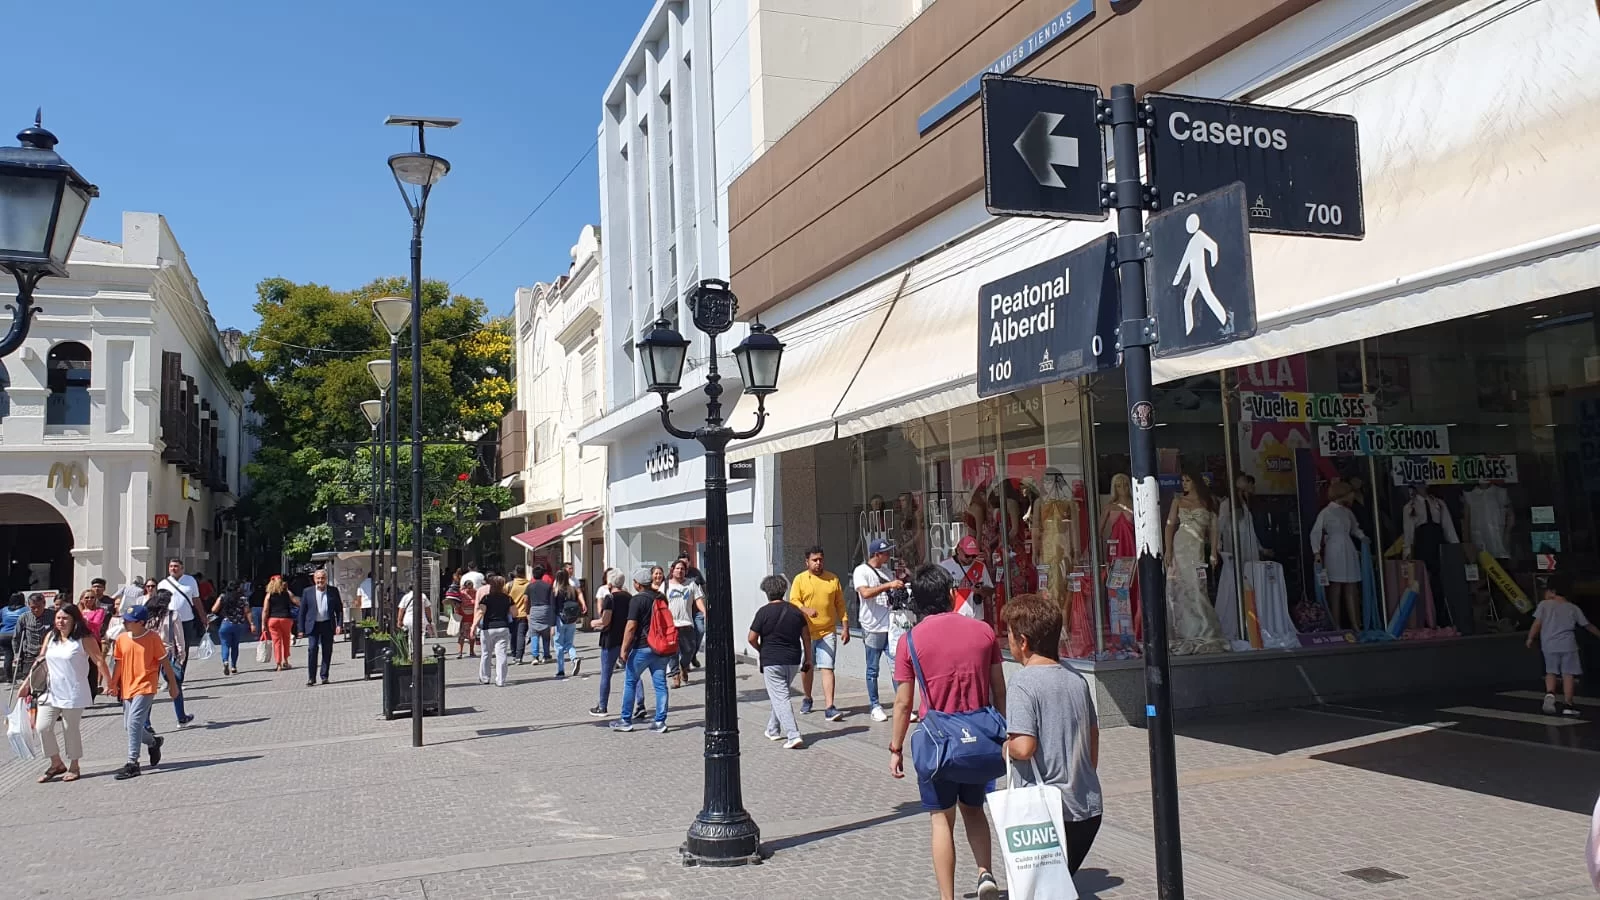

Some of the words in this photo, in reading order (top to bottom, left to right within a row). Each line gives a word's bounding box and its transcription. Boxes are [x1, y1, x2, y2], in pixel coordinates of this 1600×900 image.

[1028, 11, 1072, 53] TIENDAS
[1168, 111, 1289, 151] Caseros
[1305, 202, 1343, 226] 700
[990, 267, 1070, 319] Peatonal
[989, 302, 1055, 347] Alberdi
[988, 359, 1012, 382] 100
[1091, 335, 1103, 356] 0
[1005, 396, 1040, 417] TELAS
[1252, 396, 1299, 417] Vuelta
[1305, 401, 1313, 417] a
[1319, 397, 1366, 418] CLASES
[1328, 430, 1361, 451] Back
[1367, 430, 1384, 450] To
[1389, 430, 1440, 450] SCHOOL
[645, 446, 676, 474] adidas
[1403, 459, 1446, 480] Vuelta
[1452, 465, 1459, 480] a
[1464, 459, 1506, 479] CLASES
[1012, 826, 1057, 847] SUAVE
